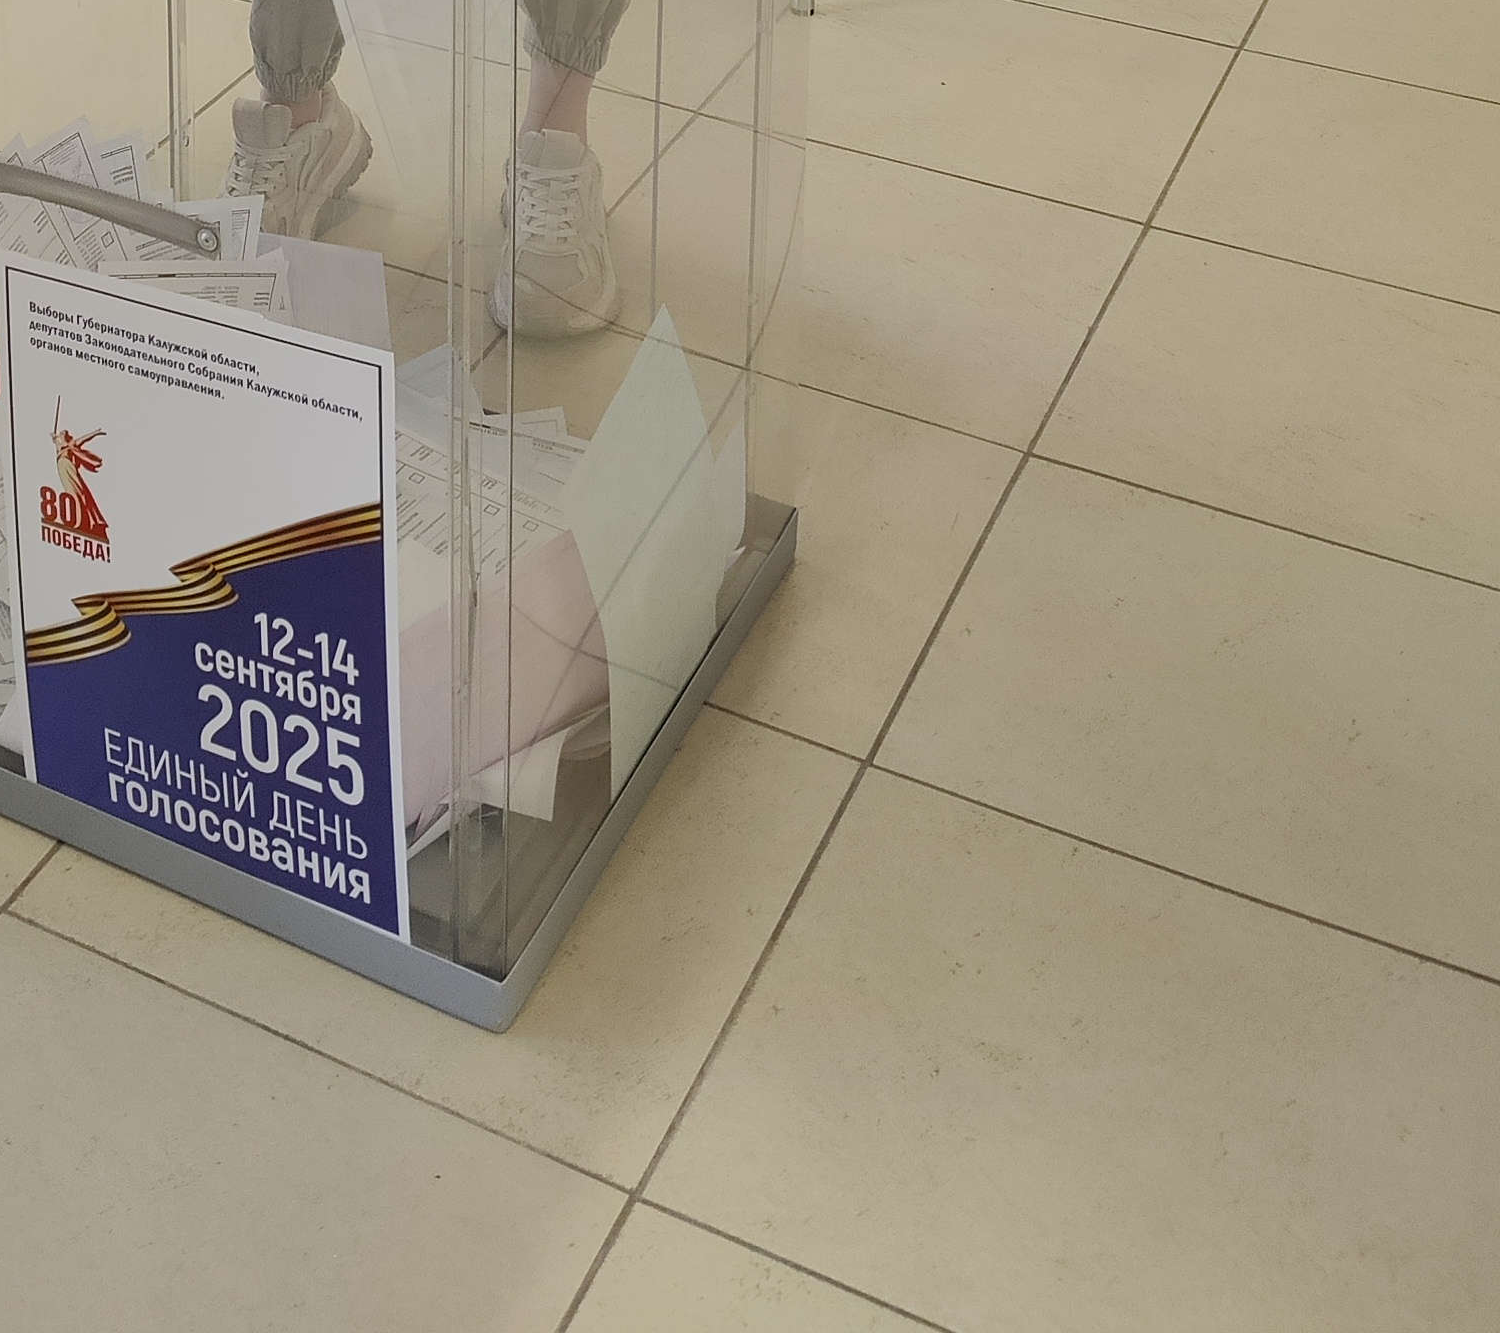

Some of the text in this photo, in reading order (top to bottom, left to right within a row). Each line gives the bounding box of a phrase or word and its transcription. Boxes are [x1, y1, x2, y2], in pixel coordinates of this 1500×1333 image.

[29, 300, 260, 377] Выборы Губернатора Калужской области,
[29, 320, 363, 423] депутатов Законодательного Собрания Калужской области,
[30, 336, 225, 400] органов местного самоуправления.
[40, 485, 77, 528] 80
[41, 524, 111, 564] ПОБЕДА!
[194, 641, 362, 725] сентября
[254, 612, 360, 686] 12-14
[197, 683, 365, 806] 2025
[103, 727, 369, 860] ЕДИНЫЙ ДЕНЬ
[108, 772, 372, 905] голосования
